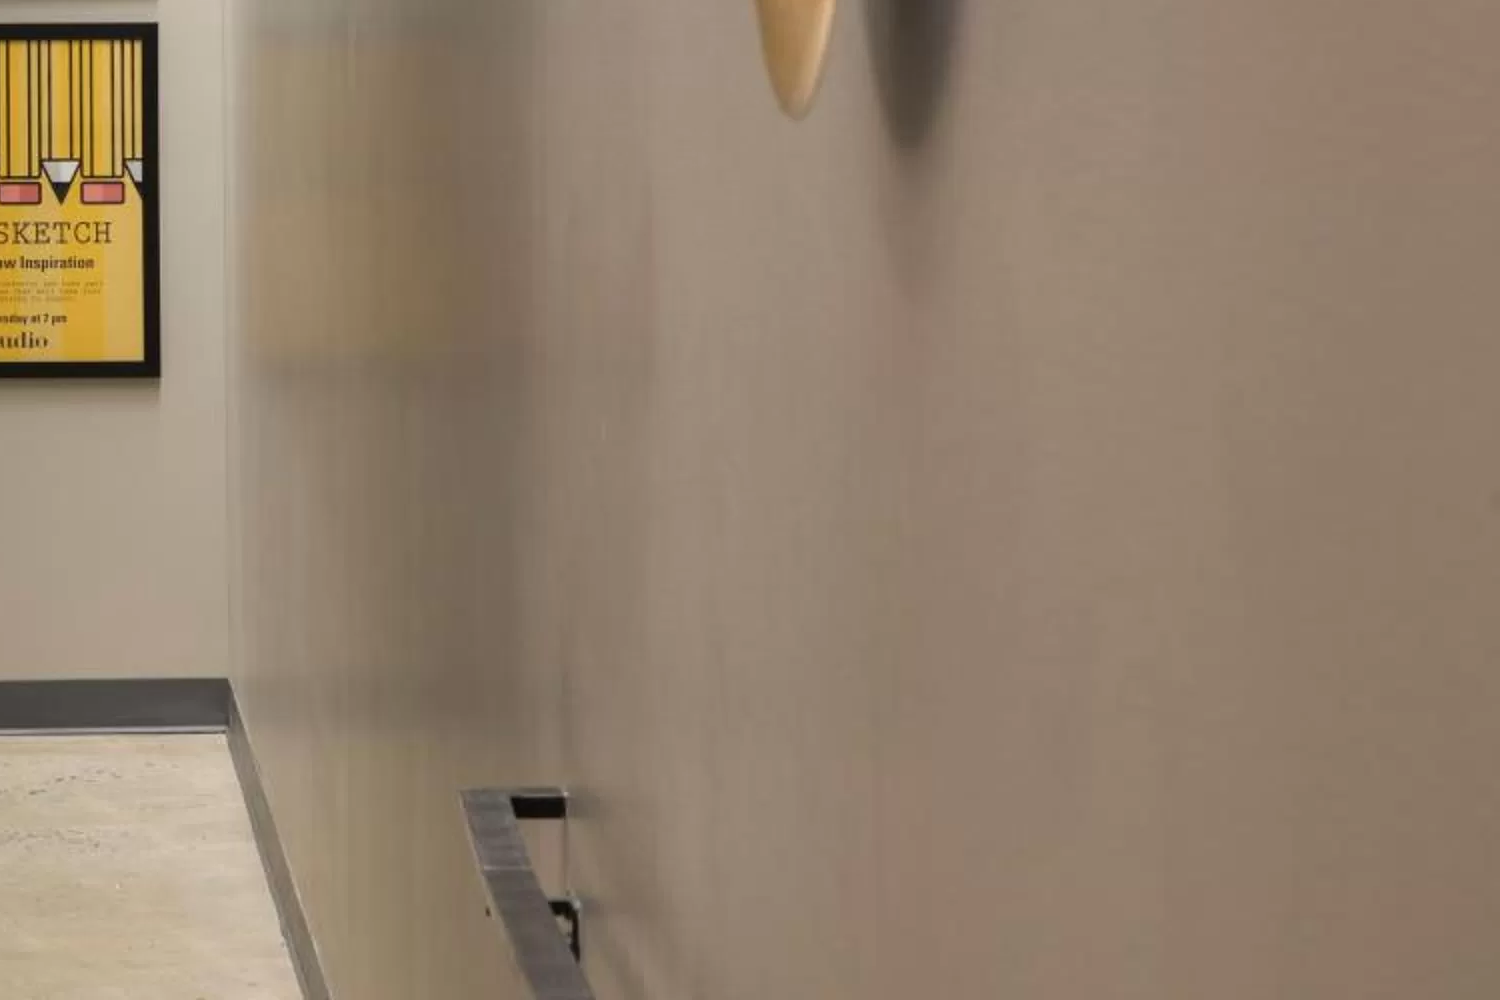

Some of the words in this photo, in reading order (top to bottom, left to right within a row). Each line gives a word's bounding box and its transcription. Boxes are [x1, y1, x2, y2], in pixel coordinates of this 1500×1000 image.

[20, 256, 95, 272] Inspiration
[31, 314, 42, 324] at
[43, 314, 49, 324] 7
[51, 315, 68, 325] pm
